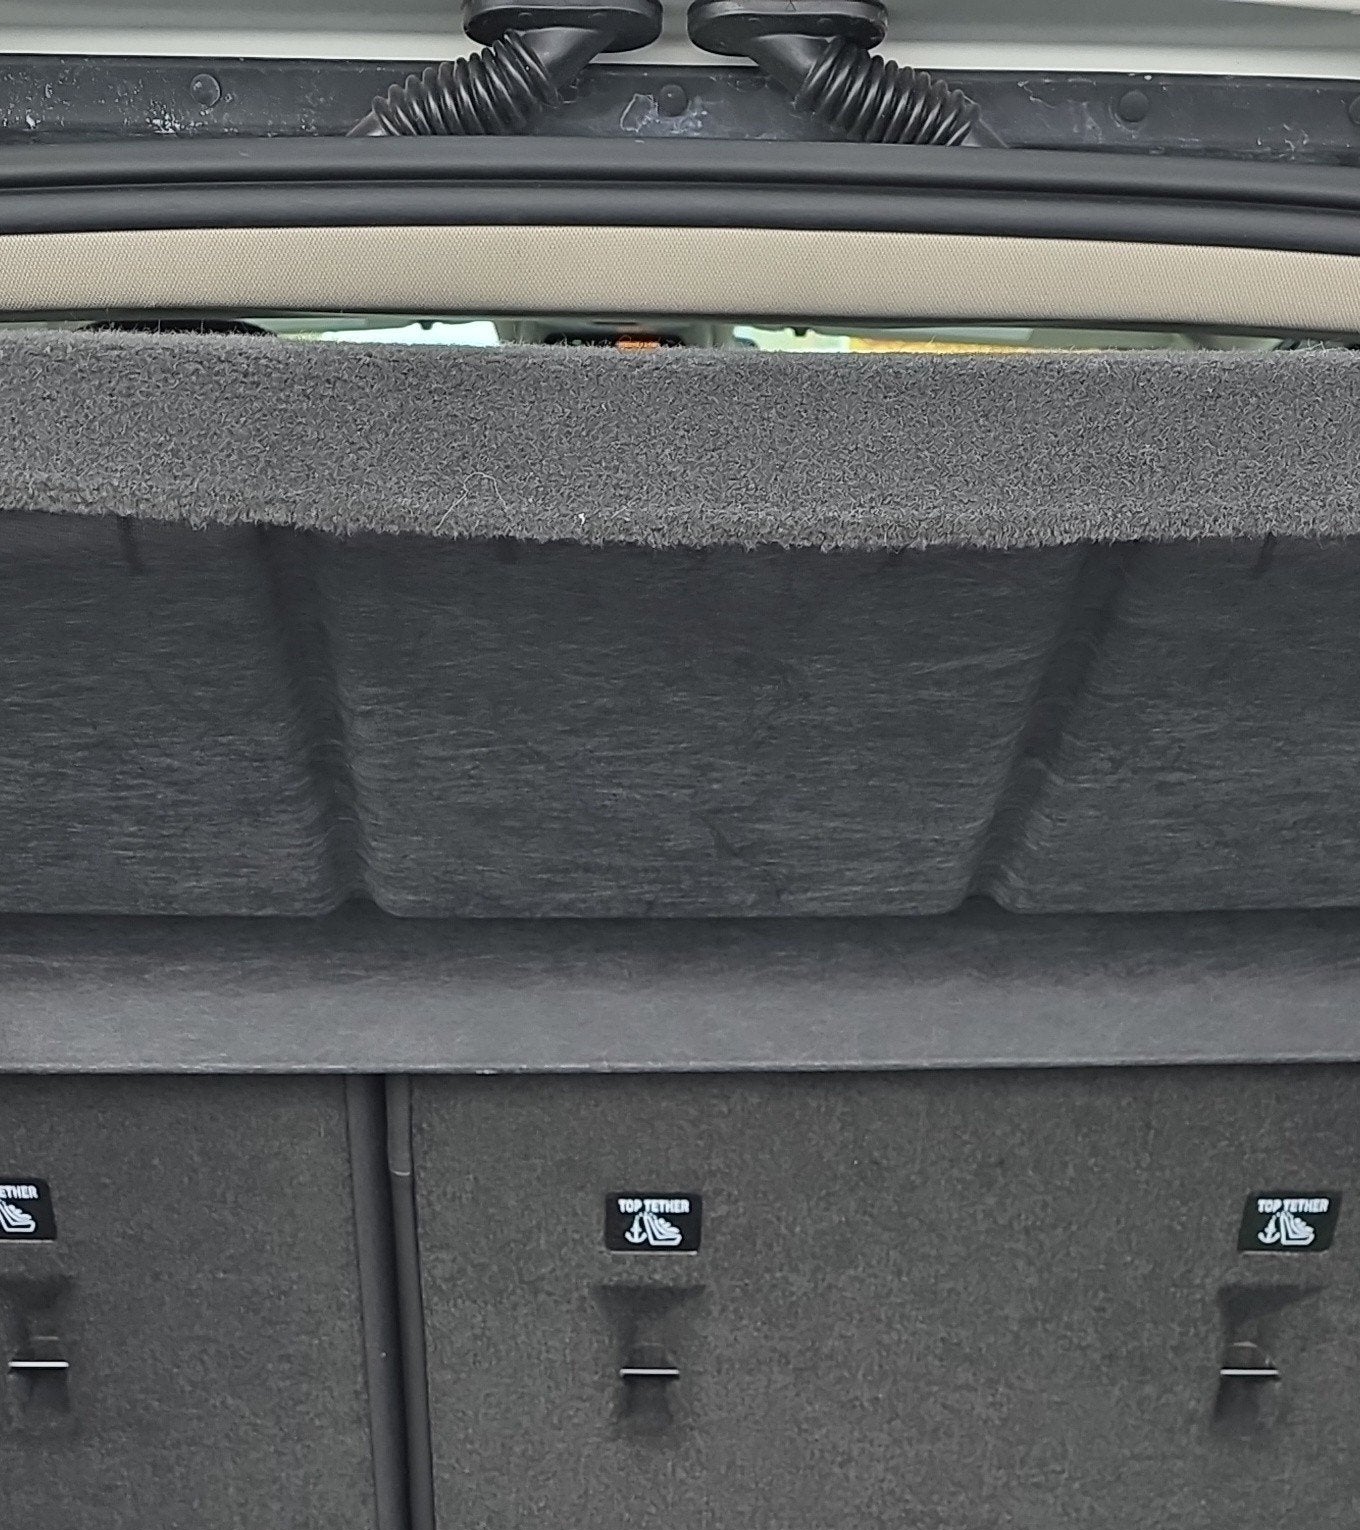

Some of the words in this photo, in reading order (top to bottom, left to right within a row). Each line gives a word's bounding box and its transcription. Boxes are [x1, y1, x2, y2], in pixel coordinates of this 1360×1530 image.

[617, 1198, 642, 1213] TOP
[643, 1198, 690, 1214] TETHER
[1257, 1198, 1282, 1213] TOP
[1283, 1198, 1330, 1213] TETHER
